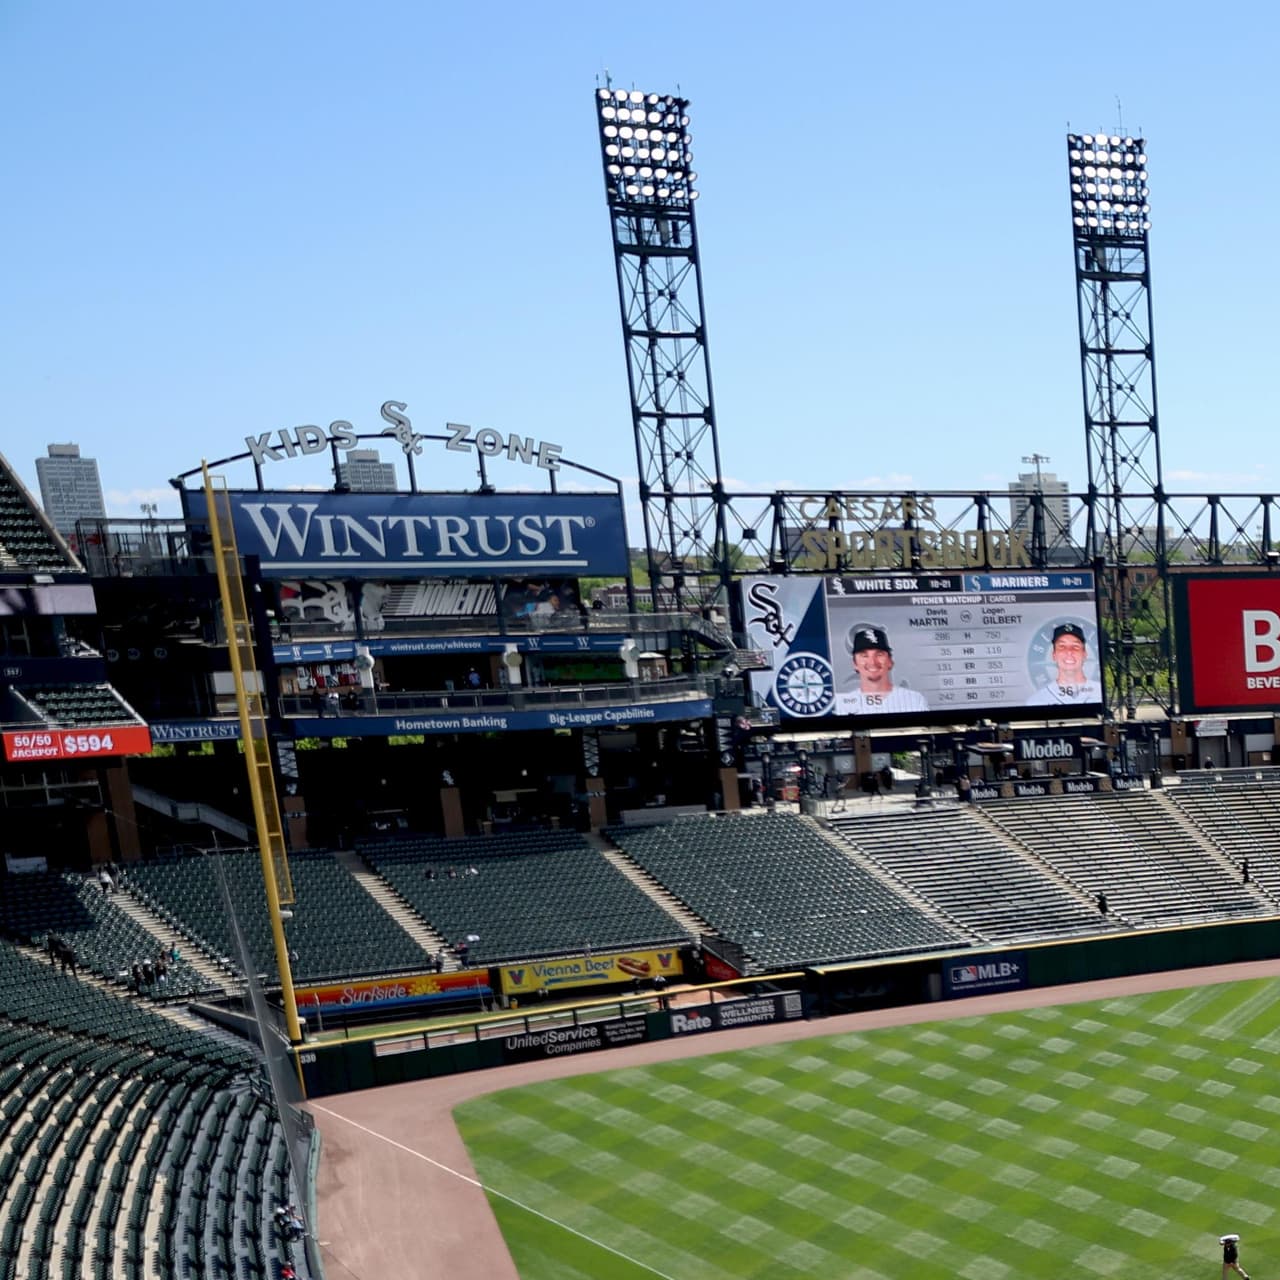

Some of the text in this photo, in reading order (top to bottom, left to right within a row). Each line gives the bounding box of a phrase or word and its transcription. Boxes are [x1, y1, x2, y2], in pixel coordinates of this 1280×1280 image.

[245, 420, 358, 464] KIDS
[446, 422, 562, 471] ZONE
[800, 497, 1032, 569] CAESARS SPORTSBOOK
[854, 577, 919, 593] WHITE SOX
[991, 576, 1049, 589] MARINERS
[909, 617, 949, 627] MARTIN
[982, 615, 1022, 625] GILBERT
[396, 716, 508, 730] Hometown Banking
[549, 708, 655, 725] Big-League Capabilities
[151, 724, 239, 740] WINTRUST
[13, 733, 52, 747] 50/50
[64, 734, 114, 753] $594
[11, 747, 58, 759] JACKPOT
[1022, 739, 1073, 759] Modelo
[1018, 784, 1045, 796] Modelo
[1067, 781, 1094, 793] Modelo
[1116, 778, 1143, 790] Modelo
[971, 787, 998, 799] Modelo
[531, 958, 616, 977] Vienna Beef
[978, 962, 1020, 979] MLB+
[340, 984, 408, 1006] Surfside
[720, 1004, 775, 1018] WELLNESS
[671, 1014, 712, 1033] Rate
[721, 1012, 776, 1026] COMMUNITY
[544, 1038, 602, 1054] Companies
